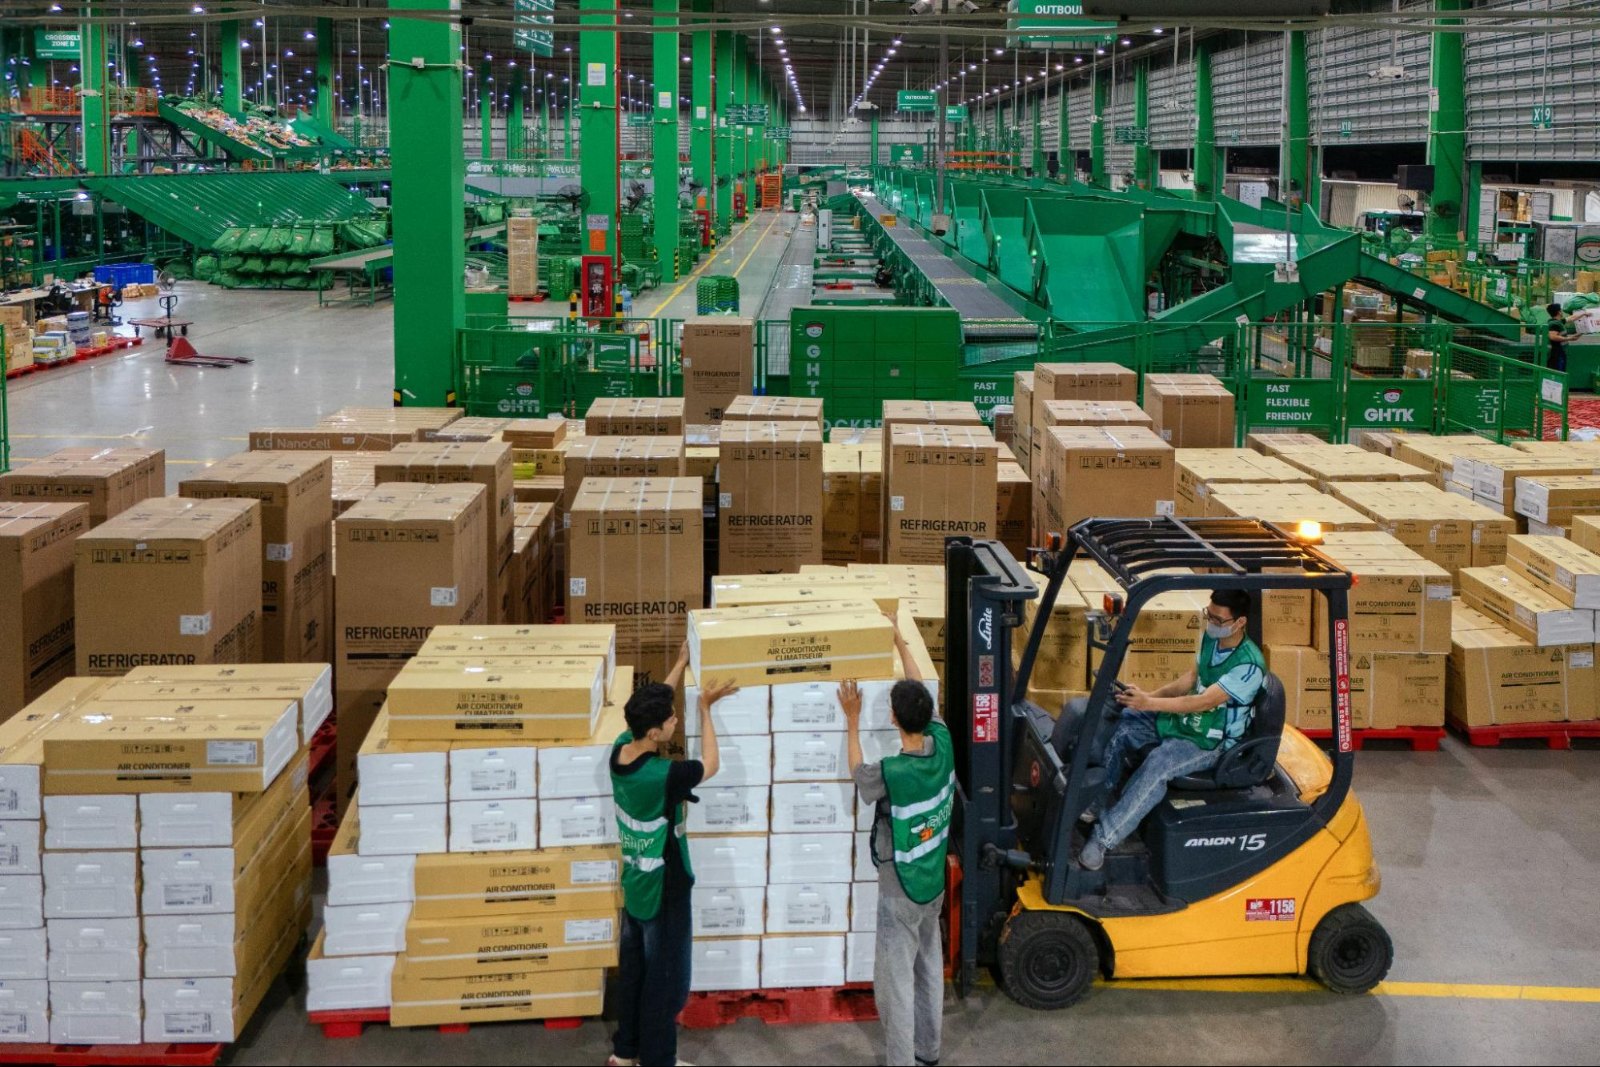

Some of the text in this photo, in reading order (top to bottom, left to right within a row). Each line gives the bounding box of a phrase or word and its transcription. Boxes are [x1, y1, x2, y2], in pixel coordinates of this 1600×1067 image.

[974, 382, 997, 391] FAST
[1266, 384, 1291, 393] FAST
[1266, 398, 1310, 407] FLEXIBLE
[1266, 411, 1312, 421] FRIENDLY
[1364, 408, 1414, 422] GHTK
[256, 438, 331, 450] LG NanoCell
[728, 515, 813, 527] REFRIGERATOR
[901, 518, 987, 533] REFRIGERATOR
[585, 600, 687, 616] REFRIGERATOR
[1355, 600, 1417, 608] AIR CONDITIONER
[978, 608, 993, 650] Linde
[767, 644, 832, 656] AIR CONDITIONER
[89, 653, 197, 668] REFRIGERATOR
[1501, 670, 1560, 679] AIR CONDITIONER
[455, 702, 523, 711] AIR CONDITIONER
[976, 694, 991, 718] 1158
[117, 762, 192, 771] AIR CONDITIONER
[1239, 833, 1267, 851] 15
[485, 883, 556, 893] AIR CONDITIONER
[1270, 900, 1295, 914] 1158
[478, 942, 549, 954] AIR CONDITIONER
[475, 989, 532, 999] CONDITIONER
